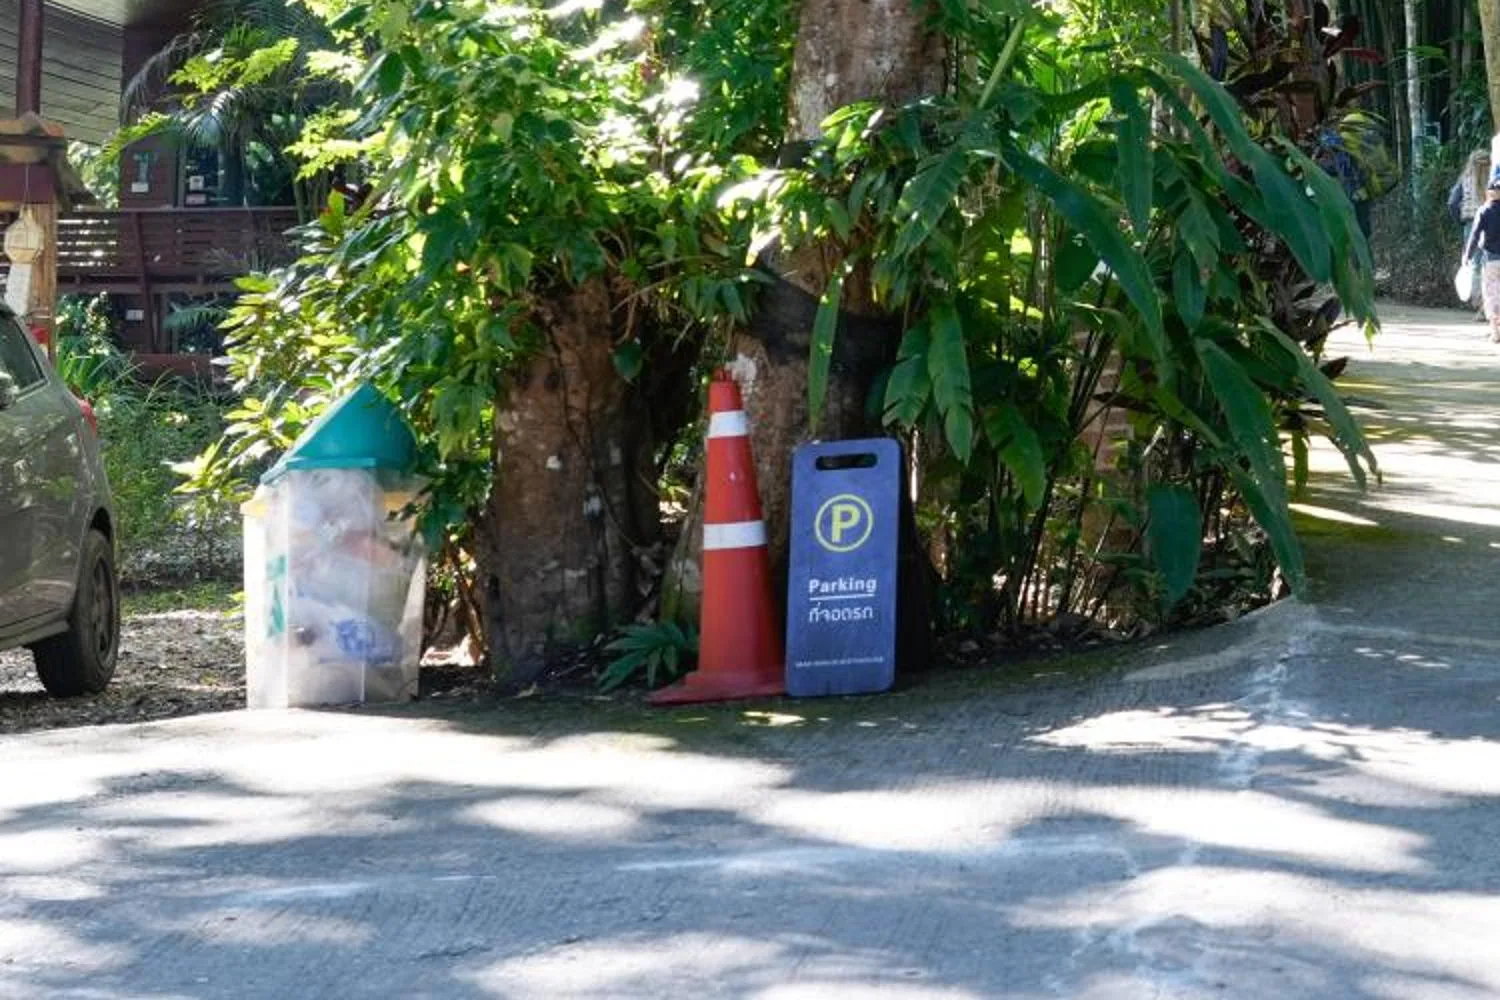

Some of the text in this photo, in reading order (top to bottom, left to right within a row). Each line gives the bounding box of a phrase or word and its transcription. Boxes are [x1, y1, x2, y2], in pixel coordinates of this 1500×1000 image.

[831, 503, 861, 543] P
[808, 577, 877, 593] Parking
[808, 601, 874, 623] ที่จอดรถ
